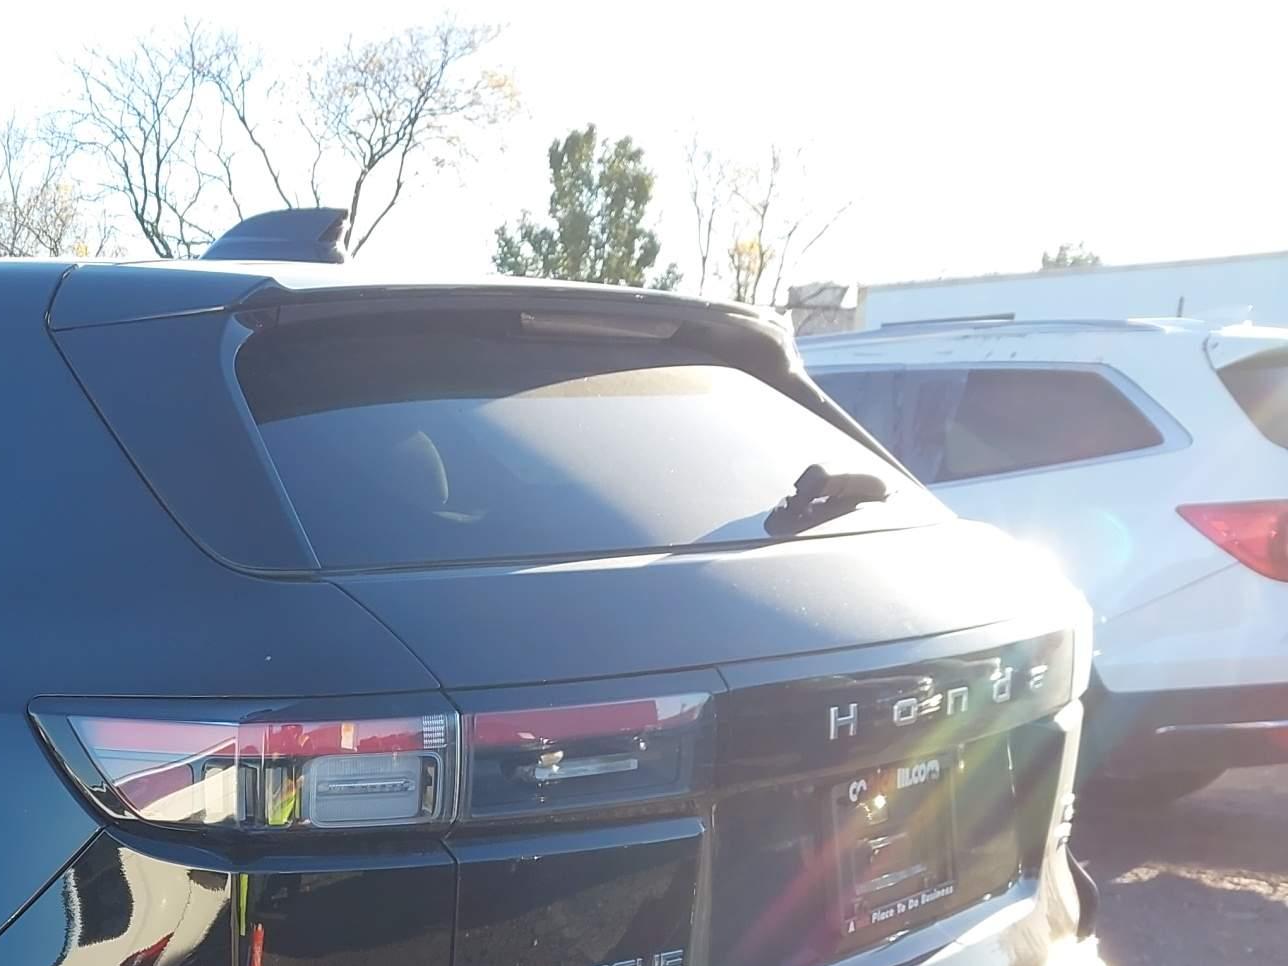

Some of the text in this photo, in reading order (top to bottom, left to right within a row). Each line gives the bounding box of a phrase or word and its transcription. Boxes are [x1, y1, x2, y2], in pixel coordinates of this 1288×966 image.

[871, 908, 894, 924] Place
[896, 902, 906, 914] To
[907, 899, 919, 910] Do
[920, 885, 954, 905] Business
